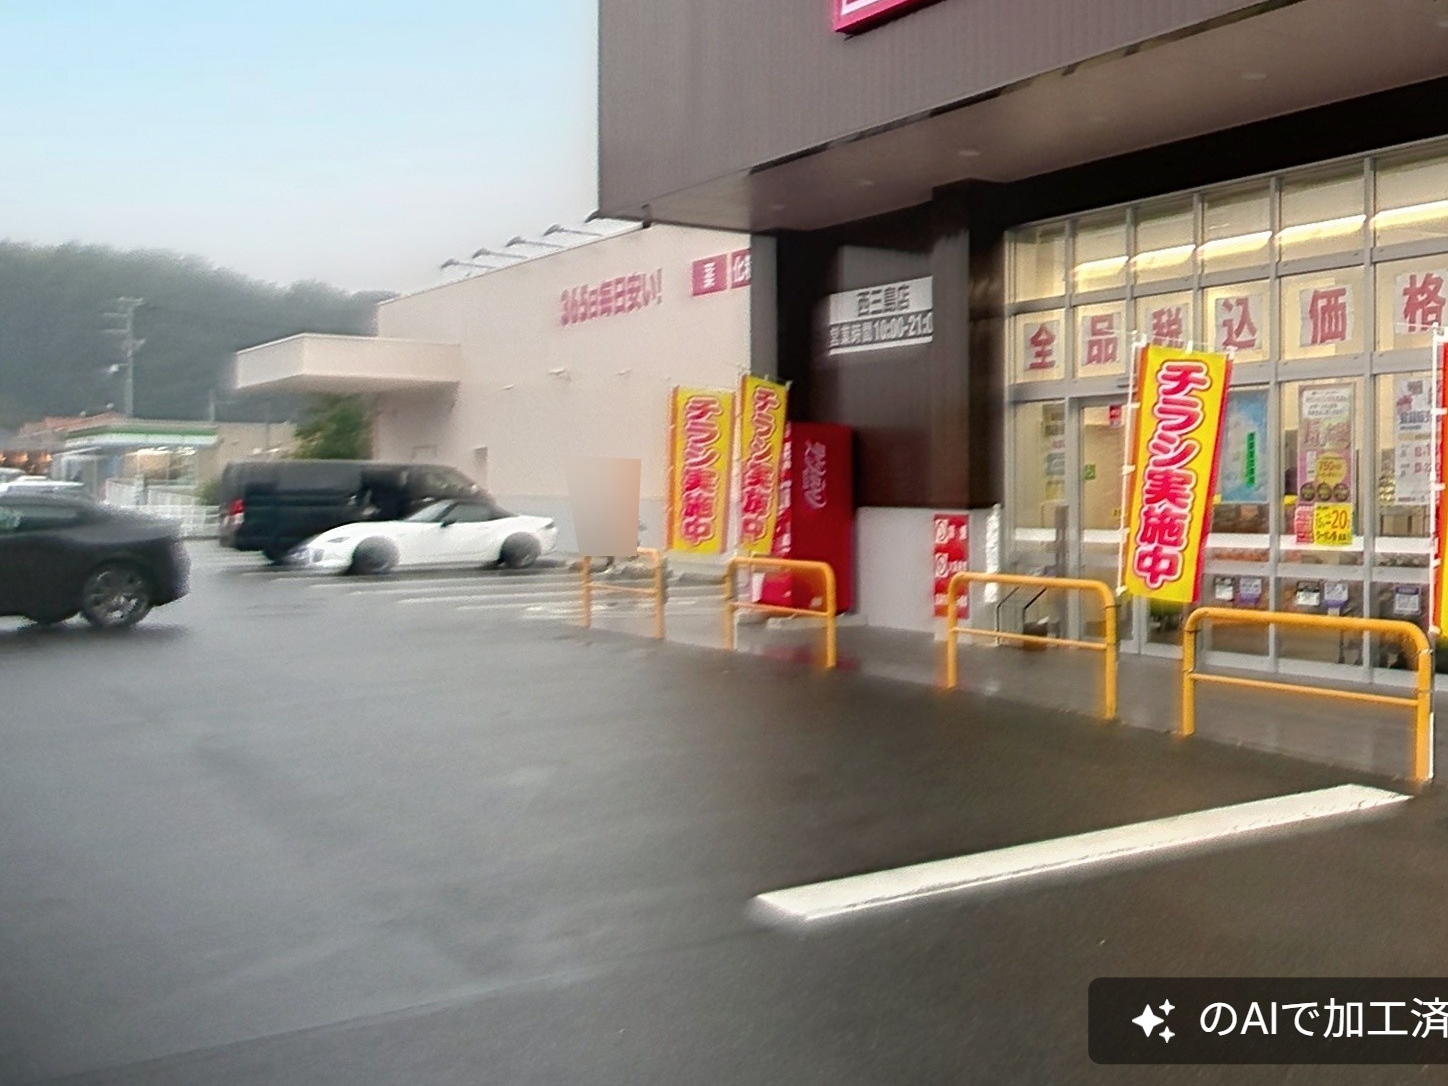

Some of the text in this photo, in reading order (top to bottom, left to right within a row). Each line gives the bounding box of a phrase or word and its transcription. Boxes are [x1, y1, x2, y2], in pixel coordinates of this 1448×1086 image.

[1134, 361, 1212, 589] チラシ実施中
